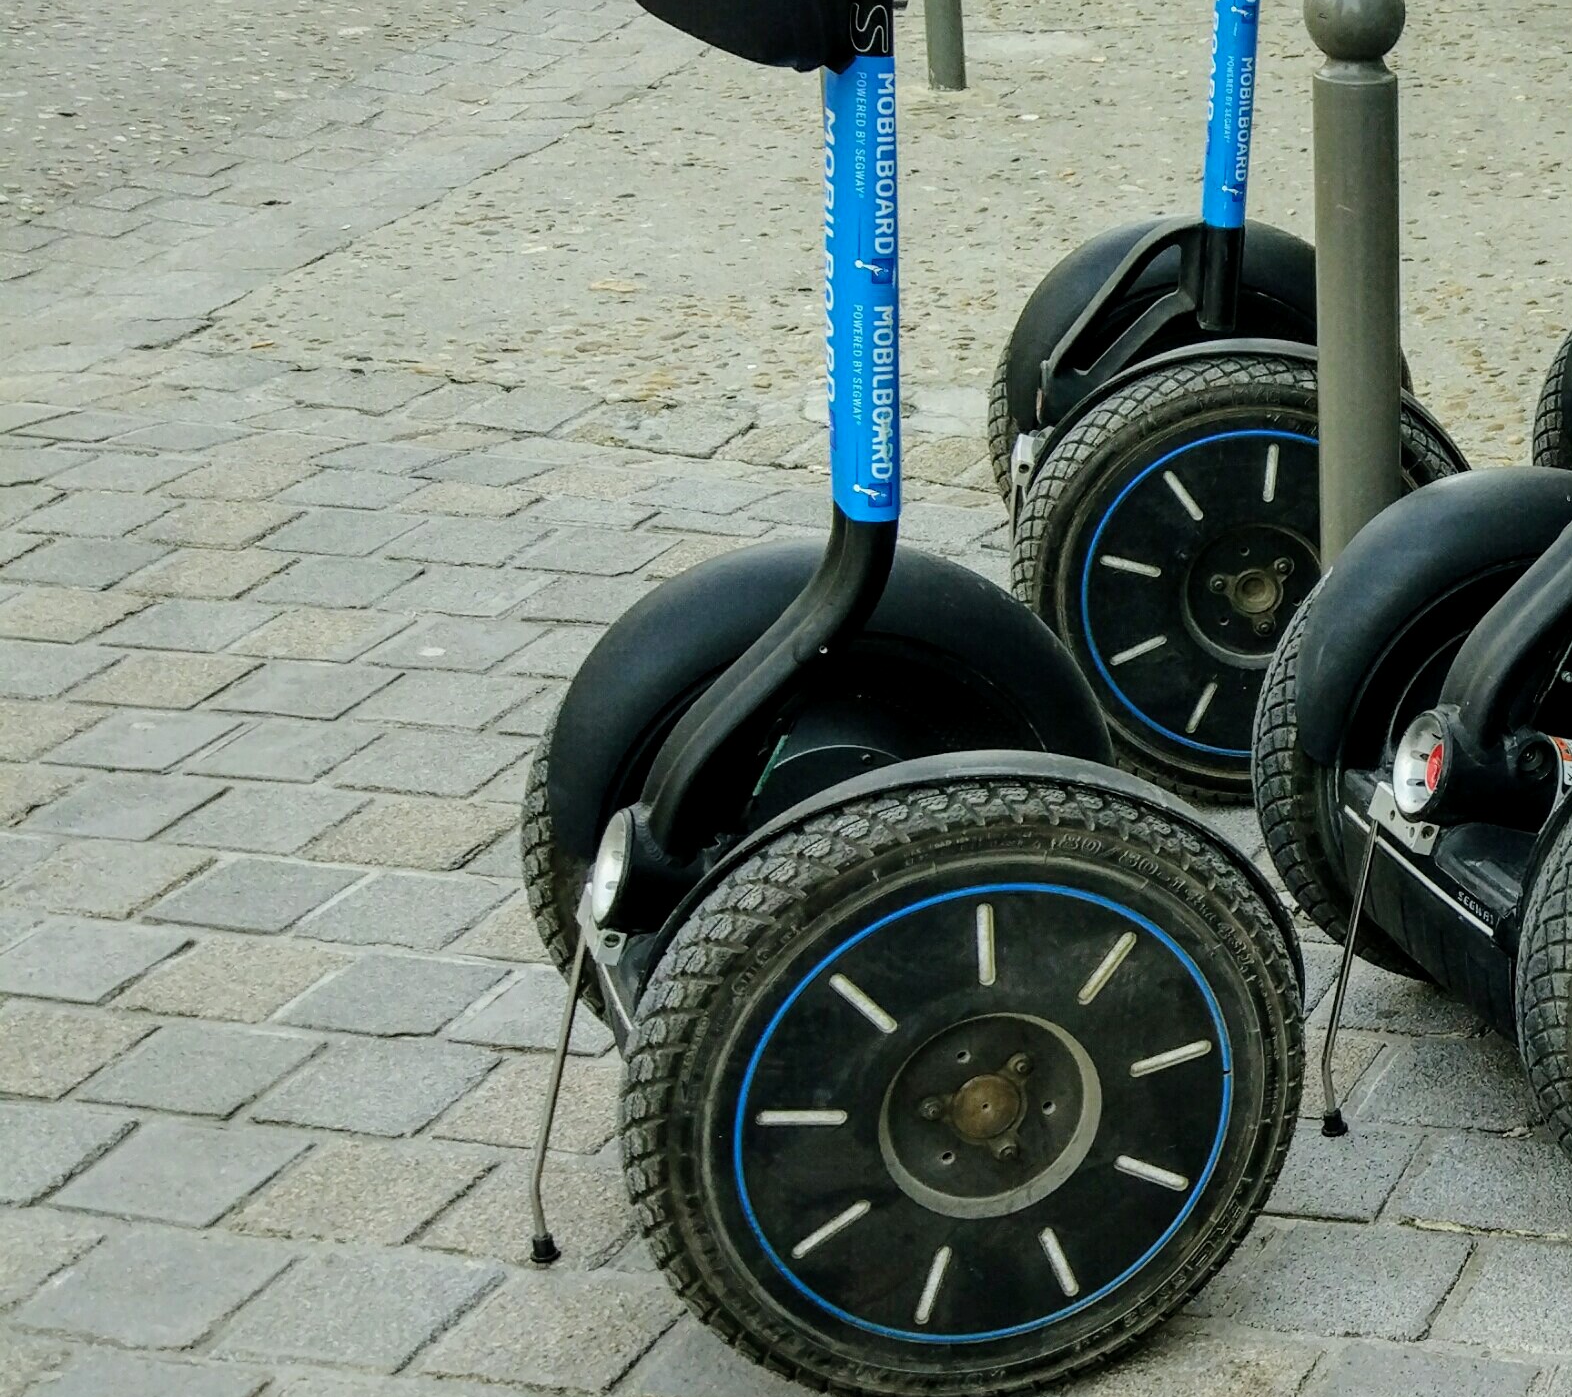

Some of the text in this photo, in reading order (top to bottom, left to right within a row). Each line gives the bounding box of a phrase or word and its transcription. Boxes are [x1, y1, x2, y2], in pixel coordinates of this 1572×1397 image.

[856, 72, 867, 128] POWERED
[1235, 57, 1253, 182] MOBILBOARD
[856, 131, 864, 146] BY
[876, 73, 895, 255] MOBILBOARD
[853, 304, 863, 359] POWERED
[852, 361, 861, 375] BY
[872, 306, 893, 482] MOBILBOARD
